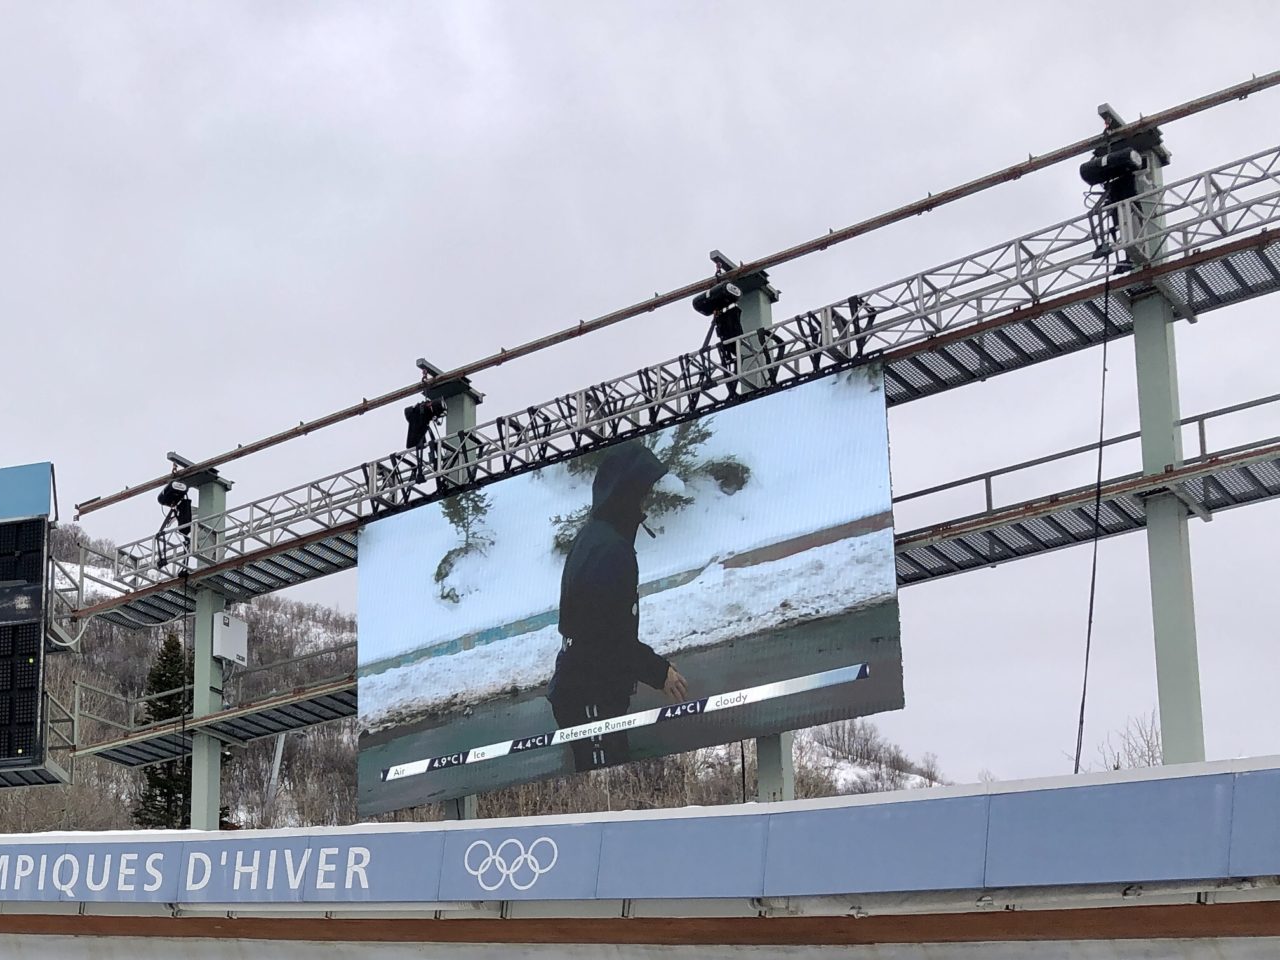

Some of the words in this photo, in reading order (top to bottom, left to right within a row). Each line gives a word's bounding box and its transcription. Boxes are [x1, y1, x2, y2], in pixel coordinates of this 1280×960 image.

[393, 767, 406, 777] Air
[473, 750, 486, 760] Ice
[559, 727, 603, 741] Reference
[604, 718, 637, 731] Runner
[715, 693, 748, 708] cloudy
[185, 846, 371, 891] D'HIVER
